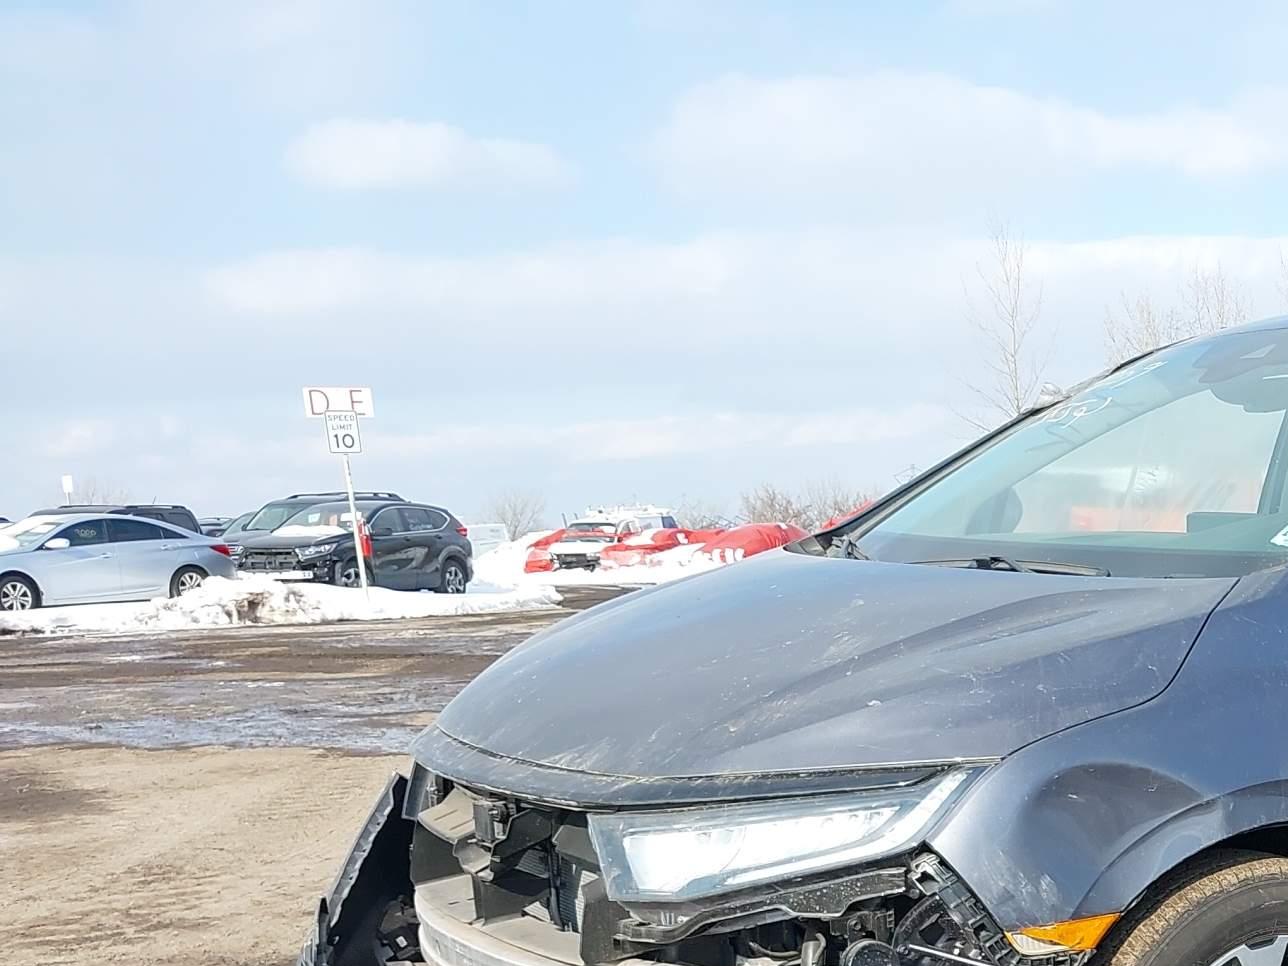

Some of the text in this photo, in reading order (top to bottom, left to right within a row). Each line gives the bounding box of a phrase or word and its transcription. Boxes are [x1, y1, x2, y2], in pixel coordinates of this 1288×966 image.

[308, 389, 366, 415] D E
[327, 414, 355, 422] SPEED
[331, 423, 353, 431] LIMIT
[333, 433, 355, 449] 10
